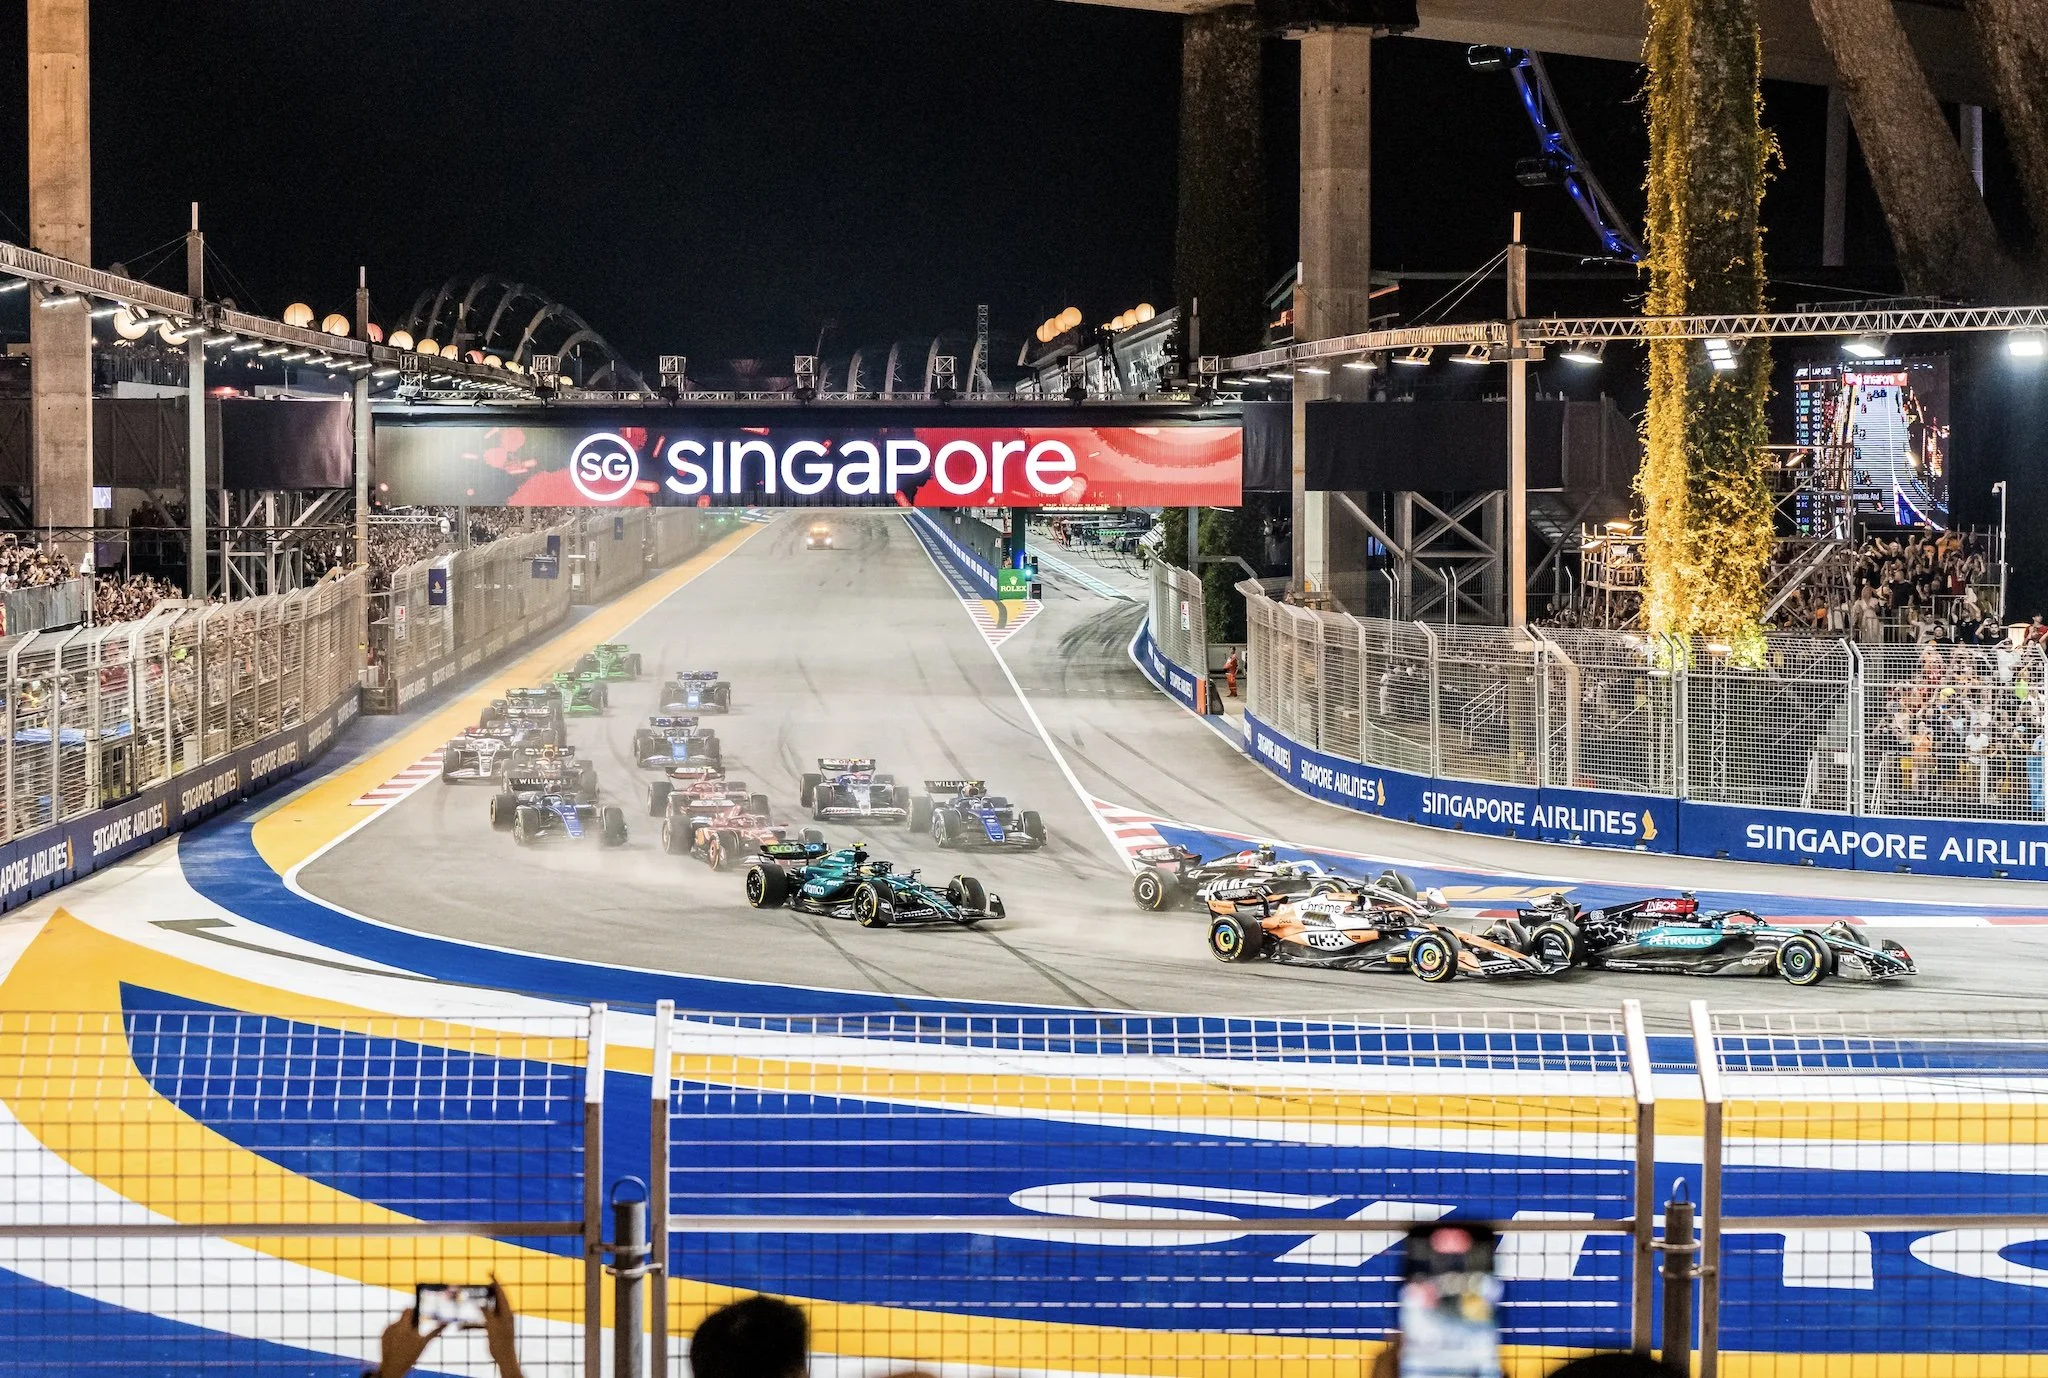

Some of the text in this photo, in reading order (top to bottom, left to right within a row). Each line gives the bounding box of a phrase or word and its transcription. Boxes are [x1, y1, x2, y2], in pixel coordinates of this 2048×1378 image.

[580, 452, 630, 481] SG
[1301, 758, 1375, 802] SINGAPORE AIRLINES
[92, 804, 163, 856] SINGAPORE AIRLINES
[1422, 791, 1637, 836] SINGAPORE AIRLINES
[30, 841, 67, 882] AIRLINES
[1746, 824, 2048, 868] SINGAPORE AIRLIN
[803, 883, 825, 896] aramco
[1301, 900, 1341, 914] Chrome
[1650, 935, 1712, 946] PETRONAS
[1839, 954, 1856, 963] IWC
